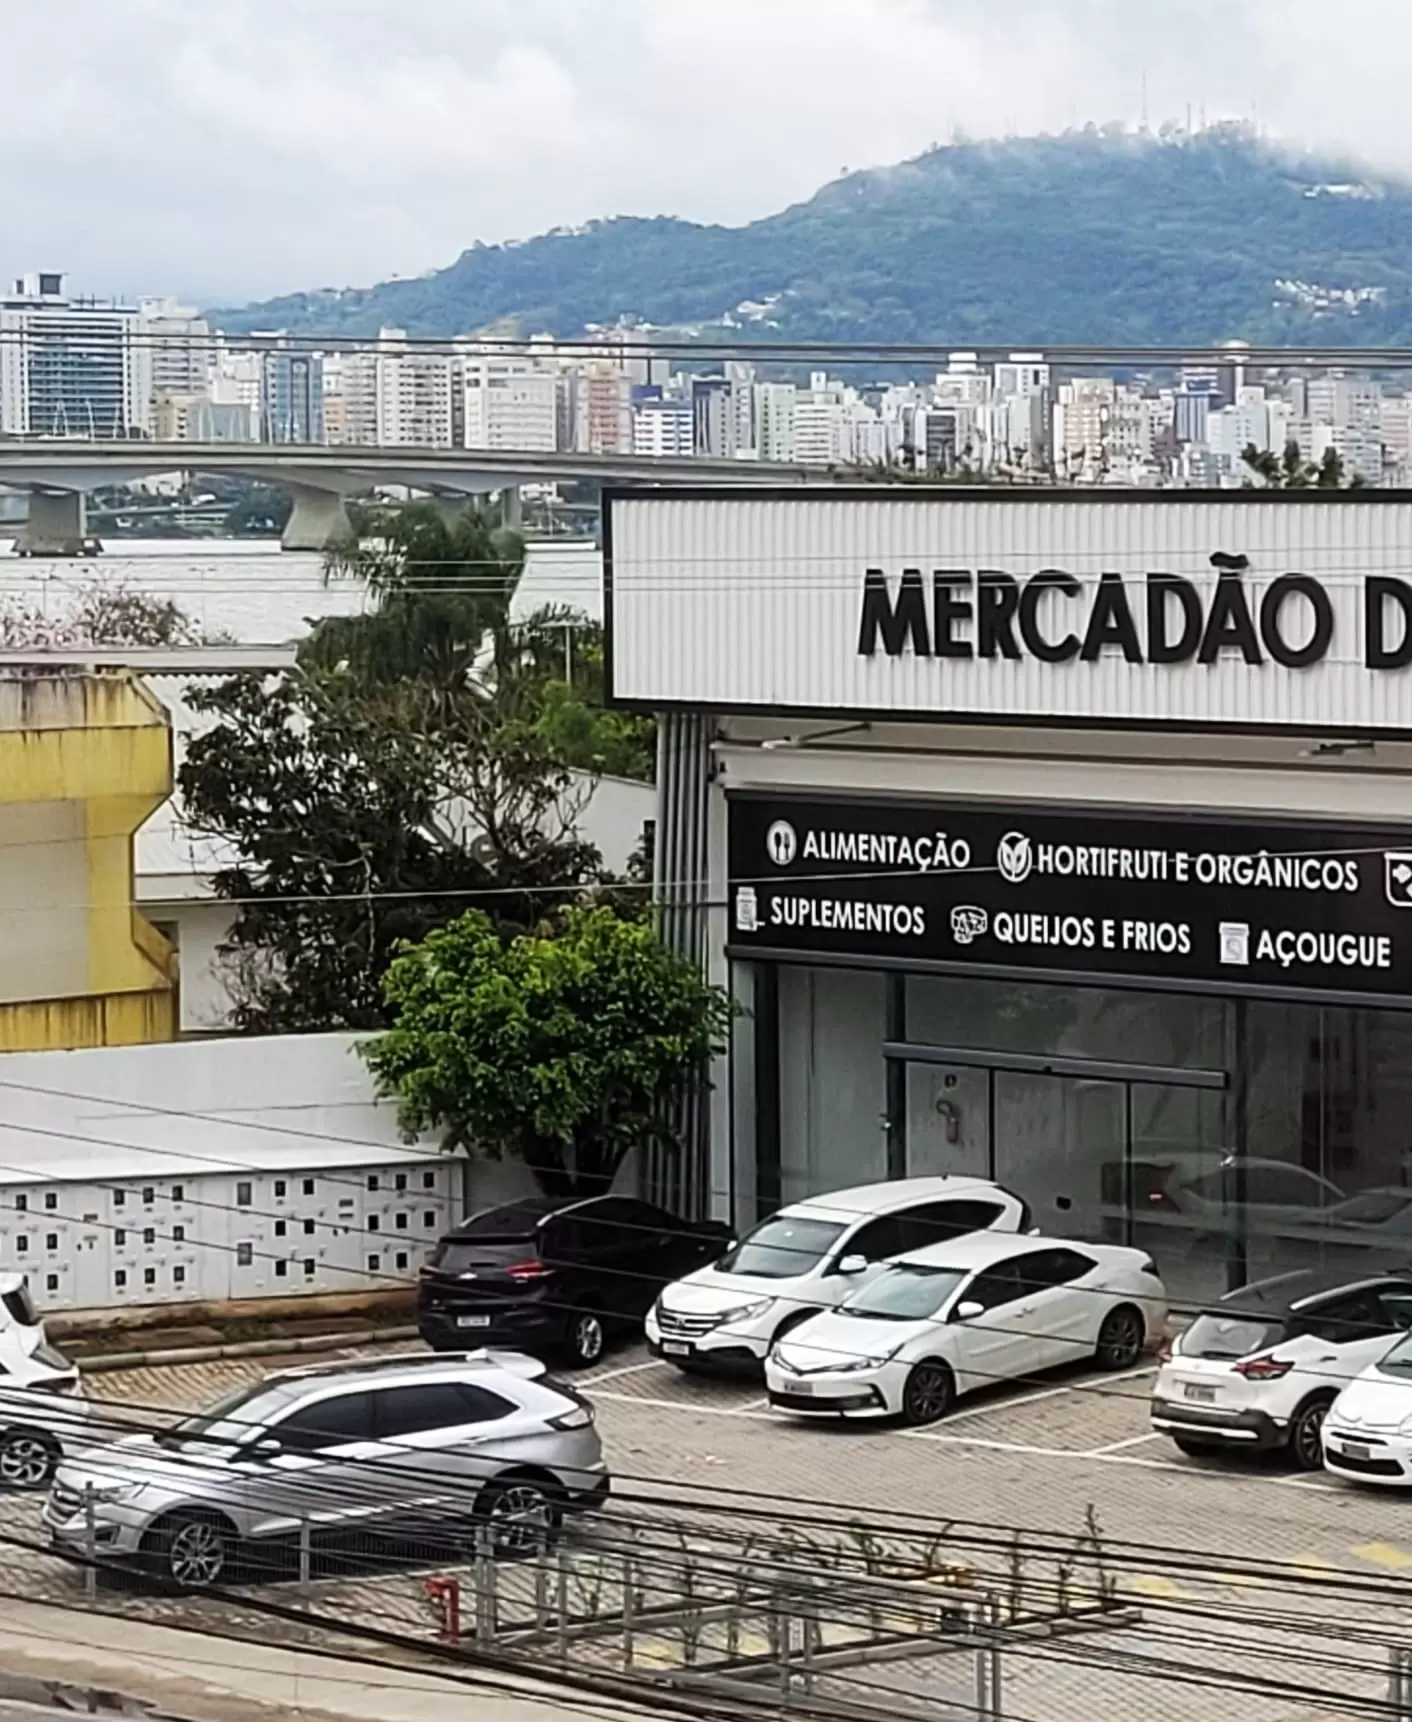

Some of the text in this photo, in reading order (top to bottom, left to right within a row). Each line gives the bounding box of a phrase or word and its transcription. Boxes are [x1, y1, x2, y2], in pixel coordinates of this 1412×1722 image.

[857, 551, 1334, 669] MERCADÃO
[803, 831, 970, 872] ALIMENTAÇÃO
[1037, 844, 1360, 891] HORTIFRUTI E ORGÂNICOS
[771, 896, 925, 935] SUPLEMENTOS
[993, 912, 1191, 955] QUEIJOS E FRIOS
[1256, 929, 1391, 969] AÇOUGUE
